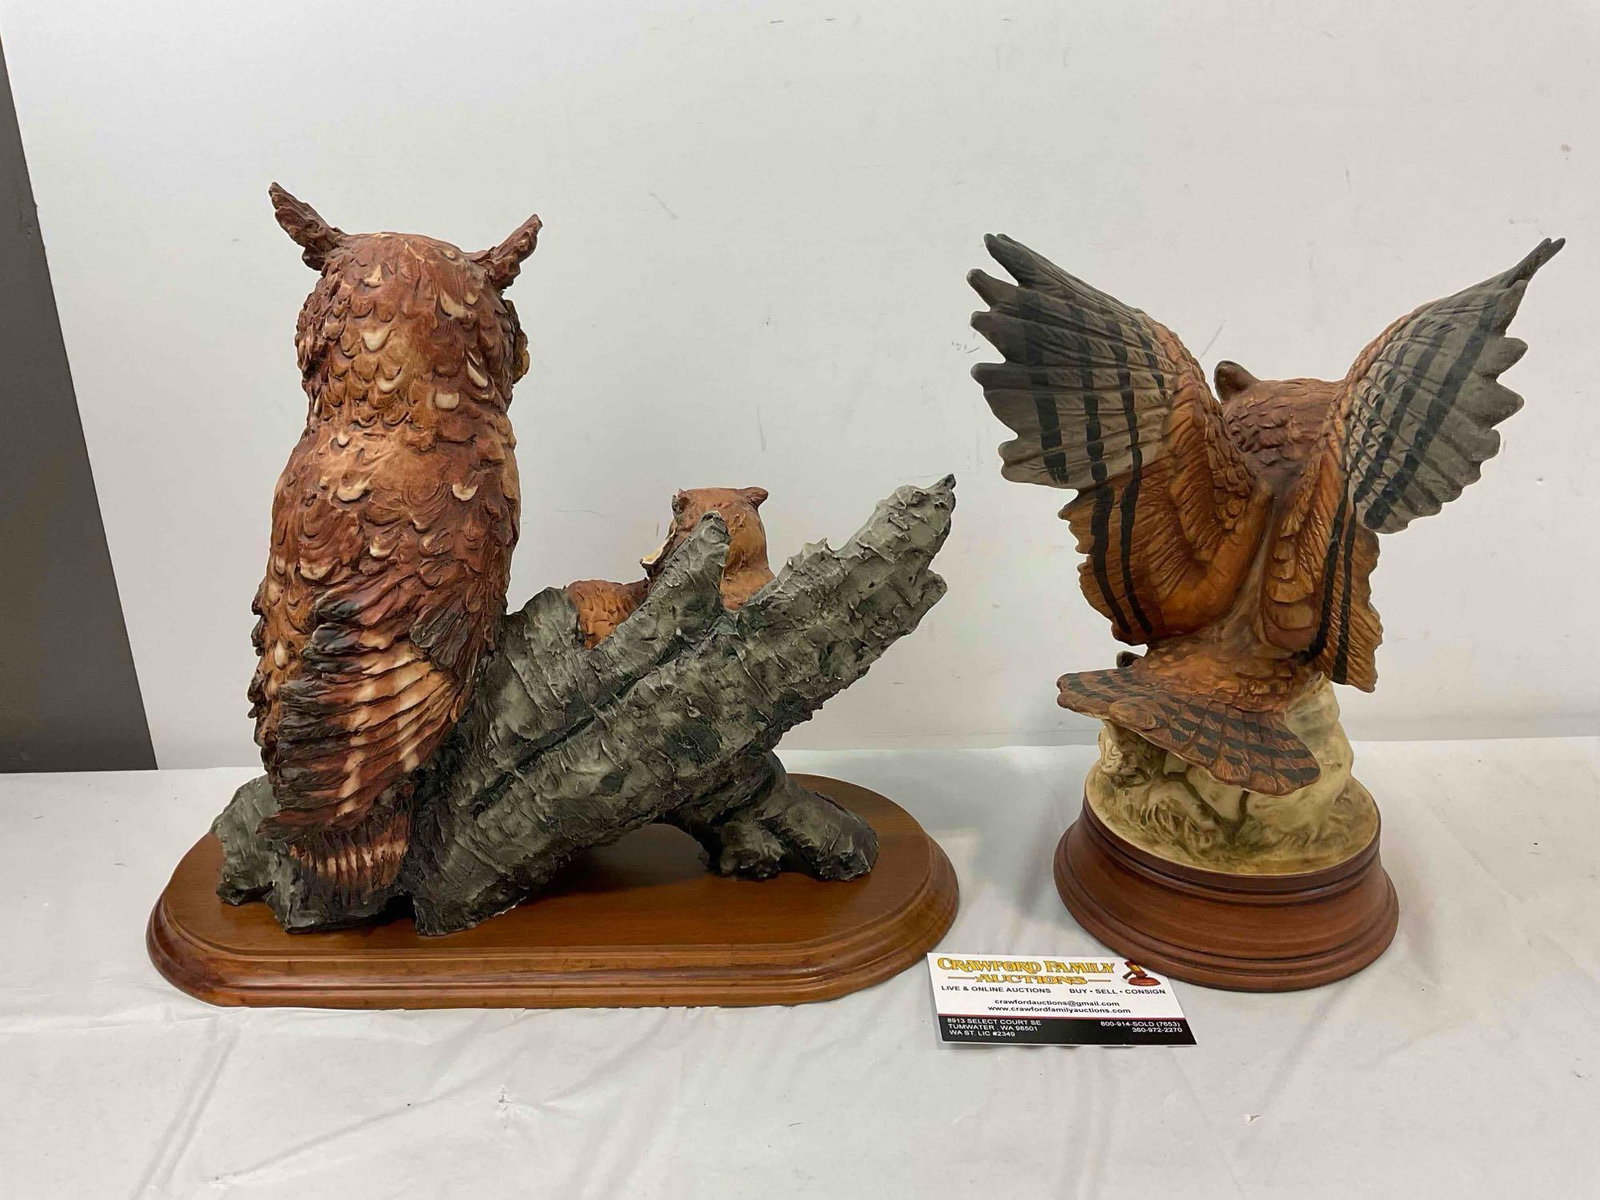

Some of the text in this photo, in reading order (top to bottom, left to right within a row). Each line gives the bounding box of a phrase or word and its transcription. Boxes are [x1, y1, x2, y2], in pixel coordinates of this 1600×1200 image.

[937, 957, 1115, 974] CRAWFORD FAMILY
[975, 974, 1088, 985] AUCTIONS
[994, 999, 1120, 1007] crawfordauctions@gmail.com
[988, 1006, 1132, 1014] www.crawfordfamilyauctions.com
